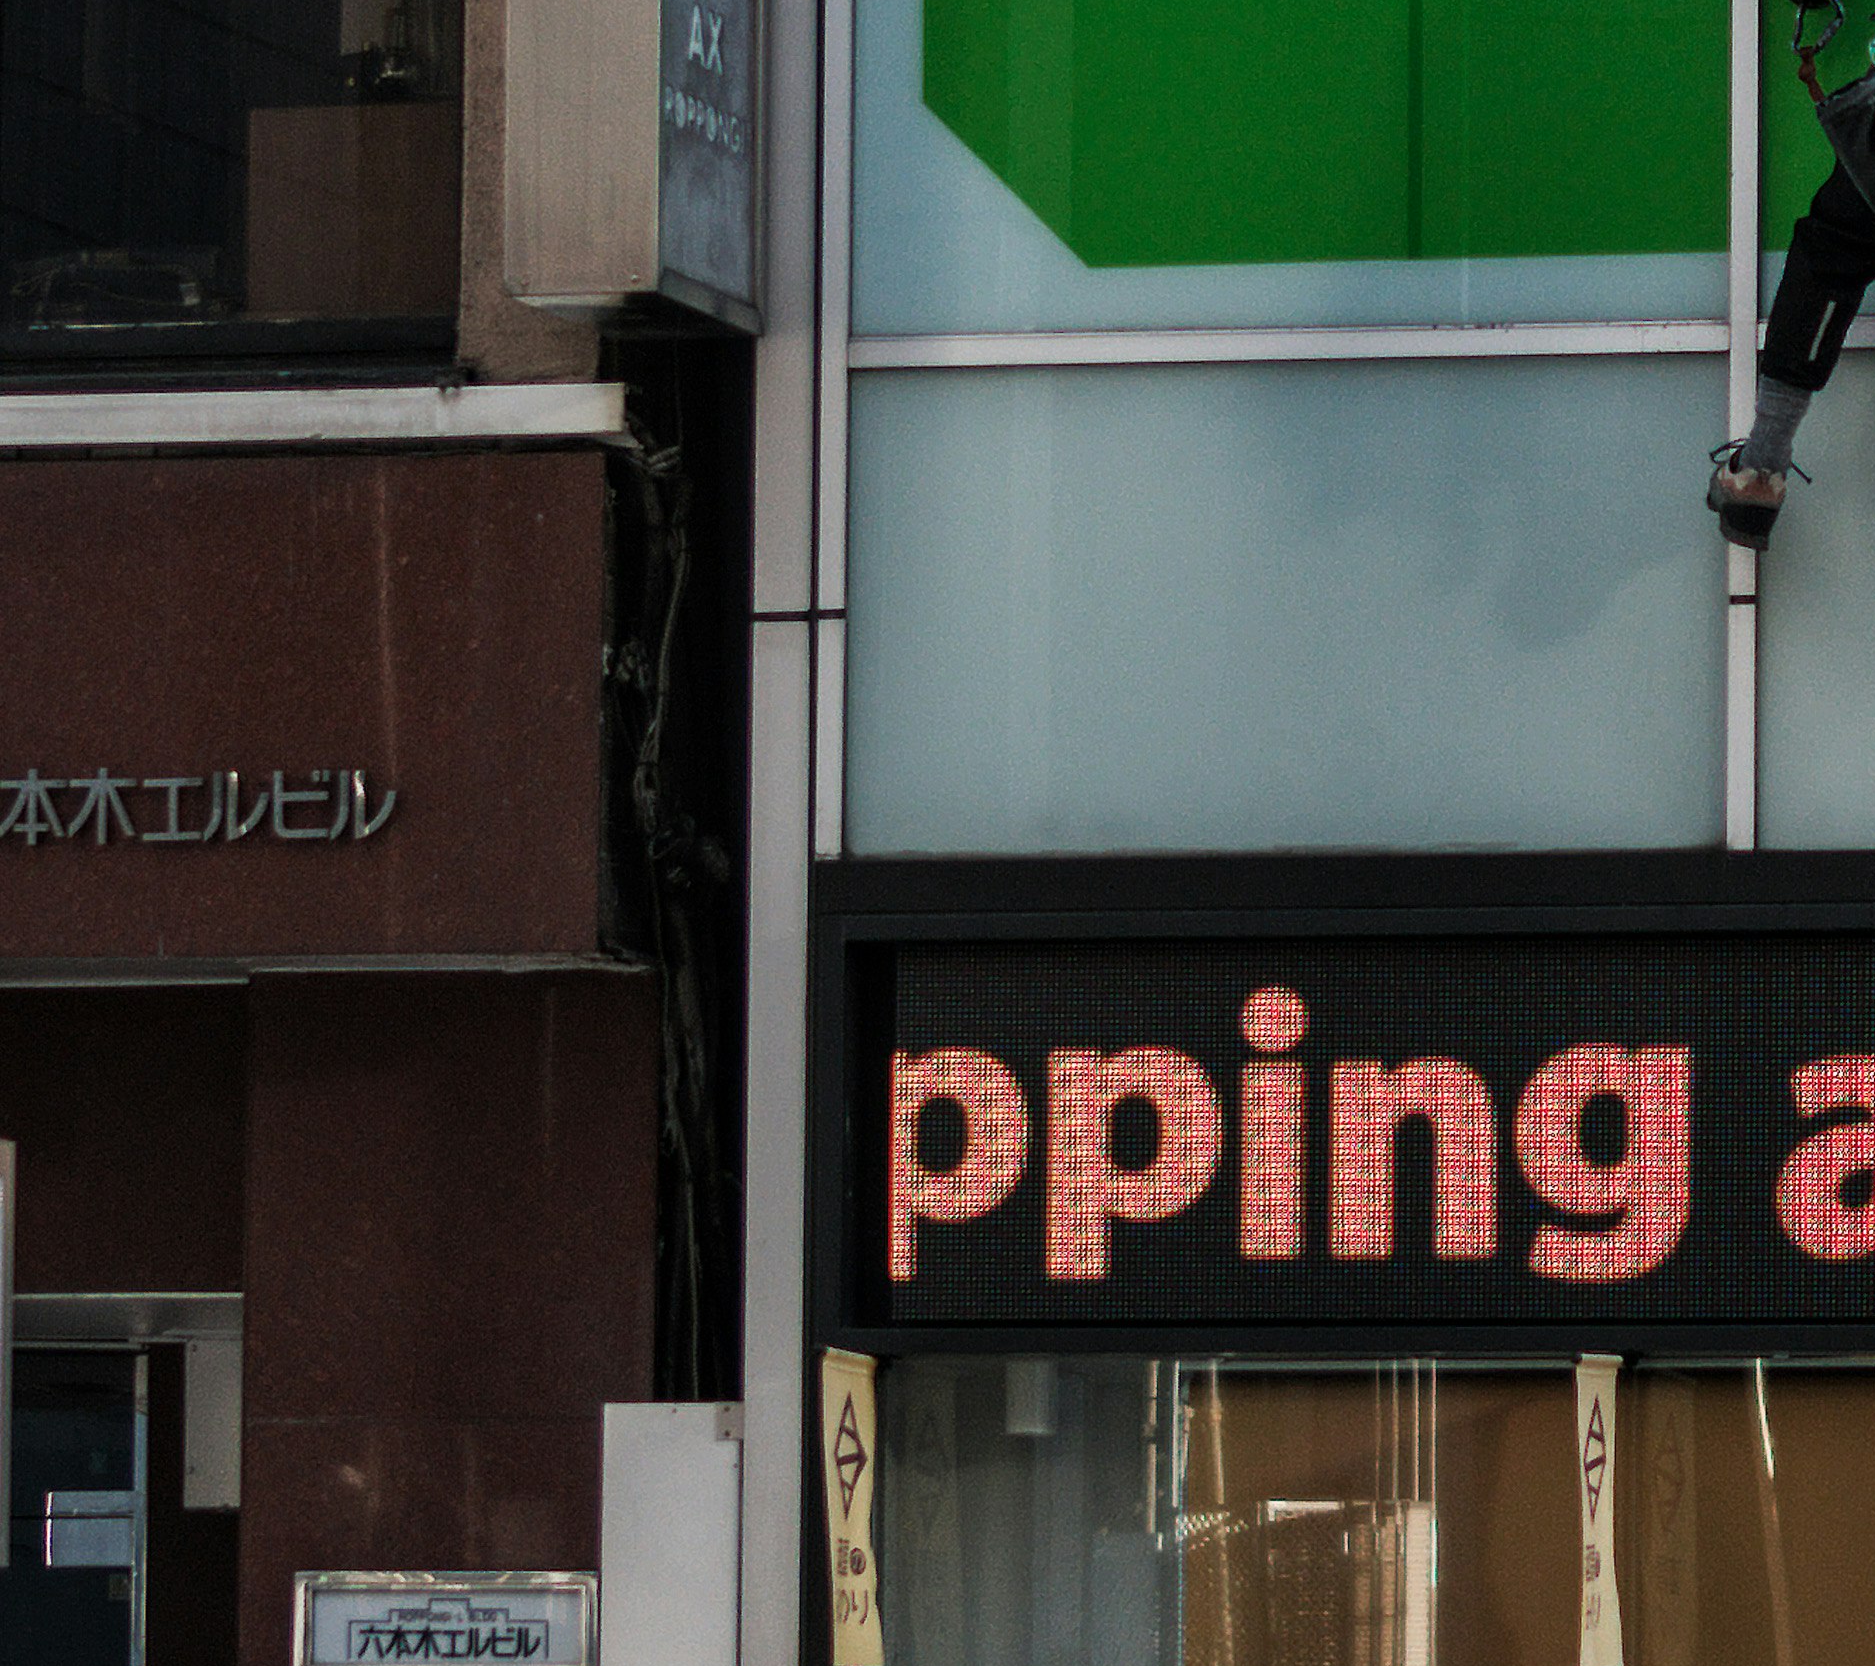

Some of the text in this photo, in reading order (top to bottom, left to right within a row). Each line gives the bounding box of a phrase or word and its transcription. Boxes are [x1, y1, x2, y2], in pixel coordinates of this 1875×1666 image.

[687, 6, 723, 76] AX
[0, 768, 397, 846] 本木エルビル
[888, 987, 1691, 1281] pping
[357, 1625, 542, 1660] 六本木エルビル
